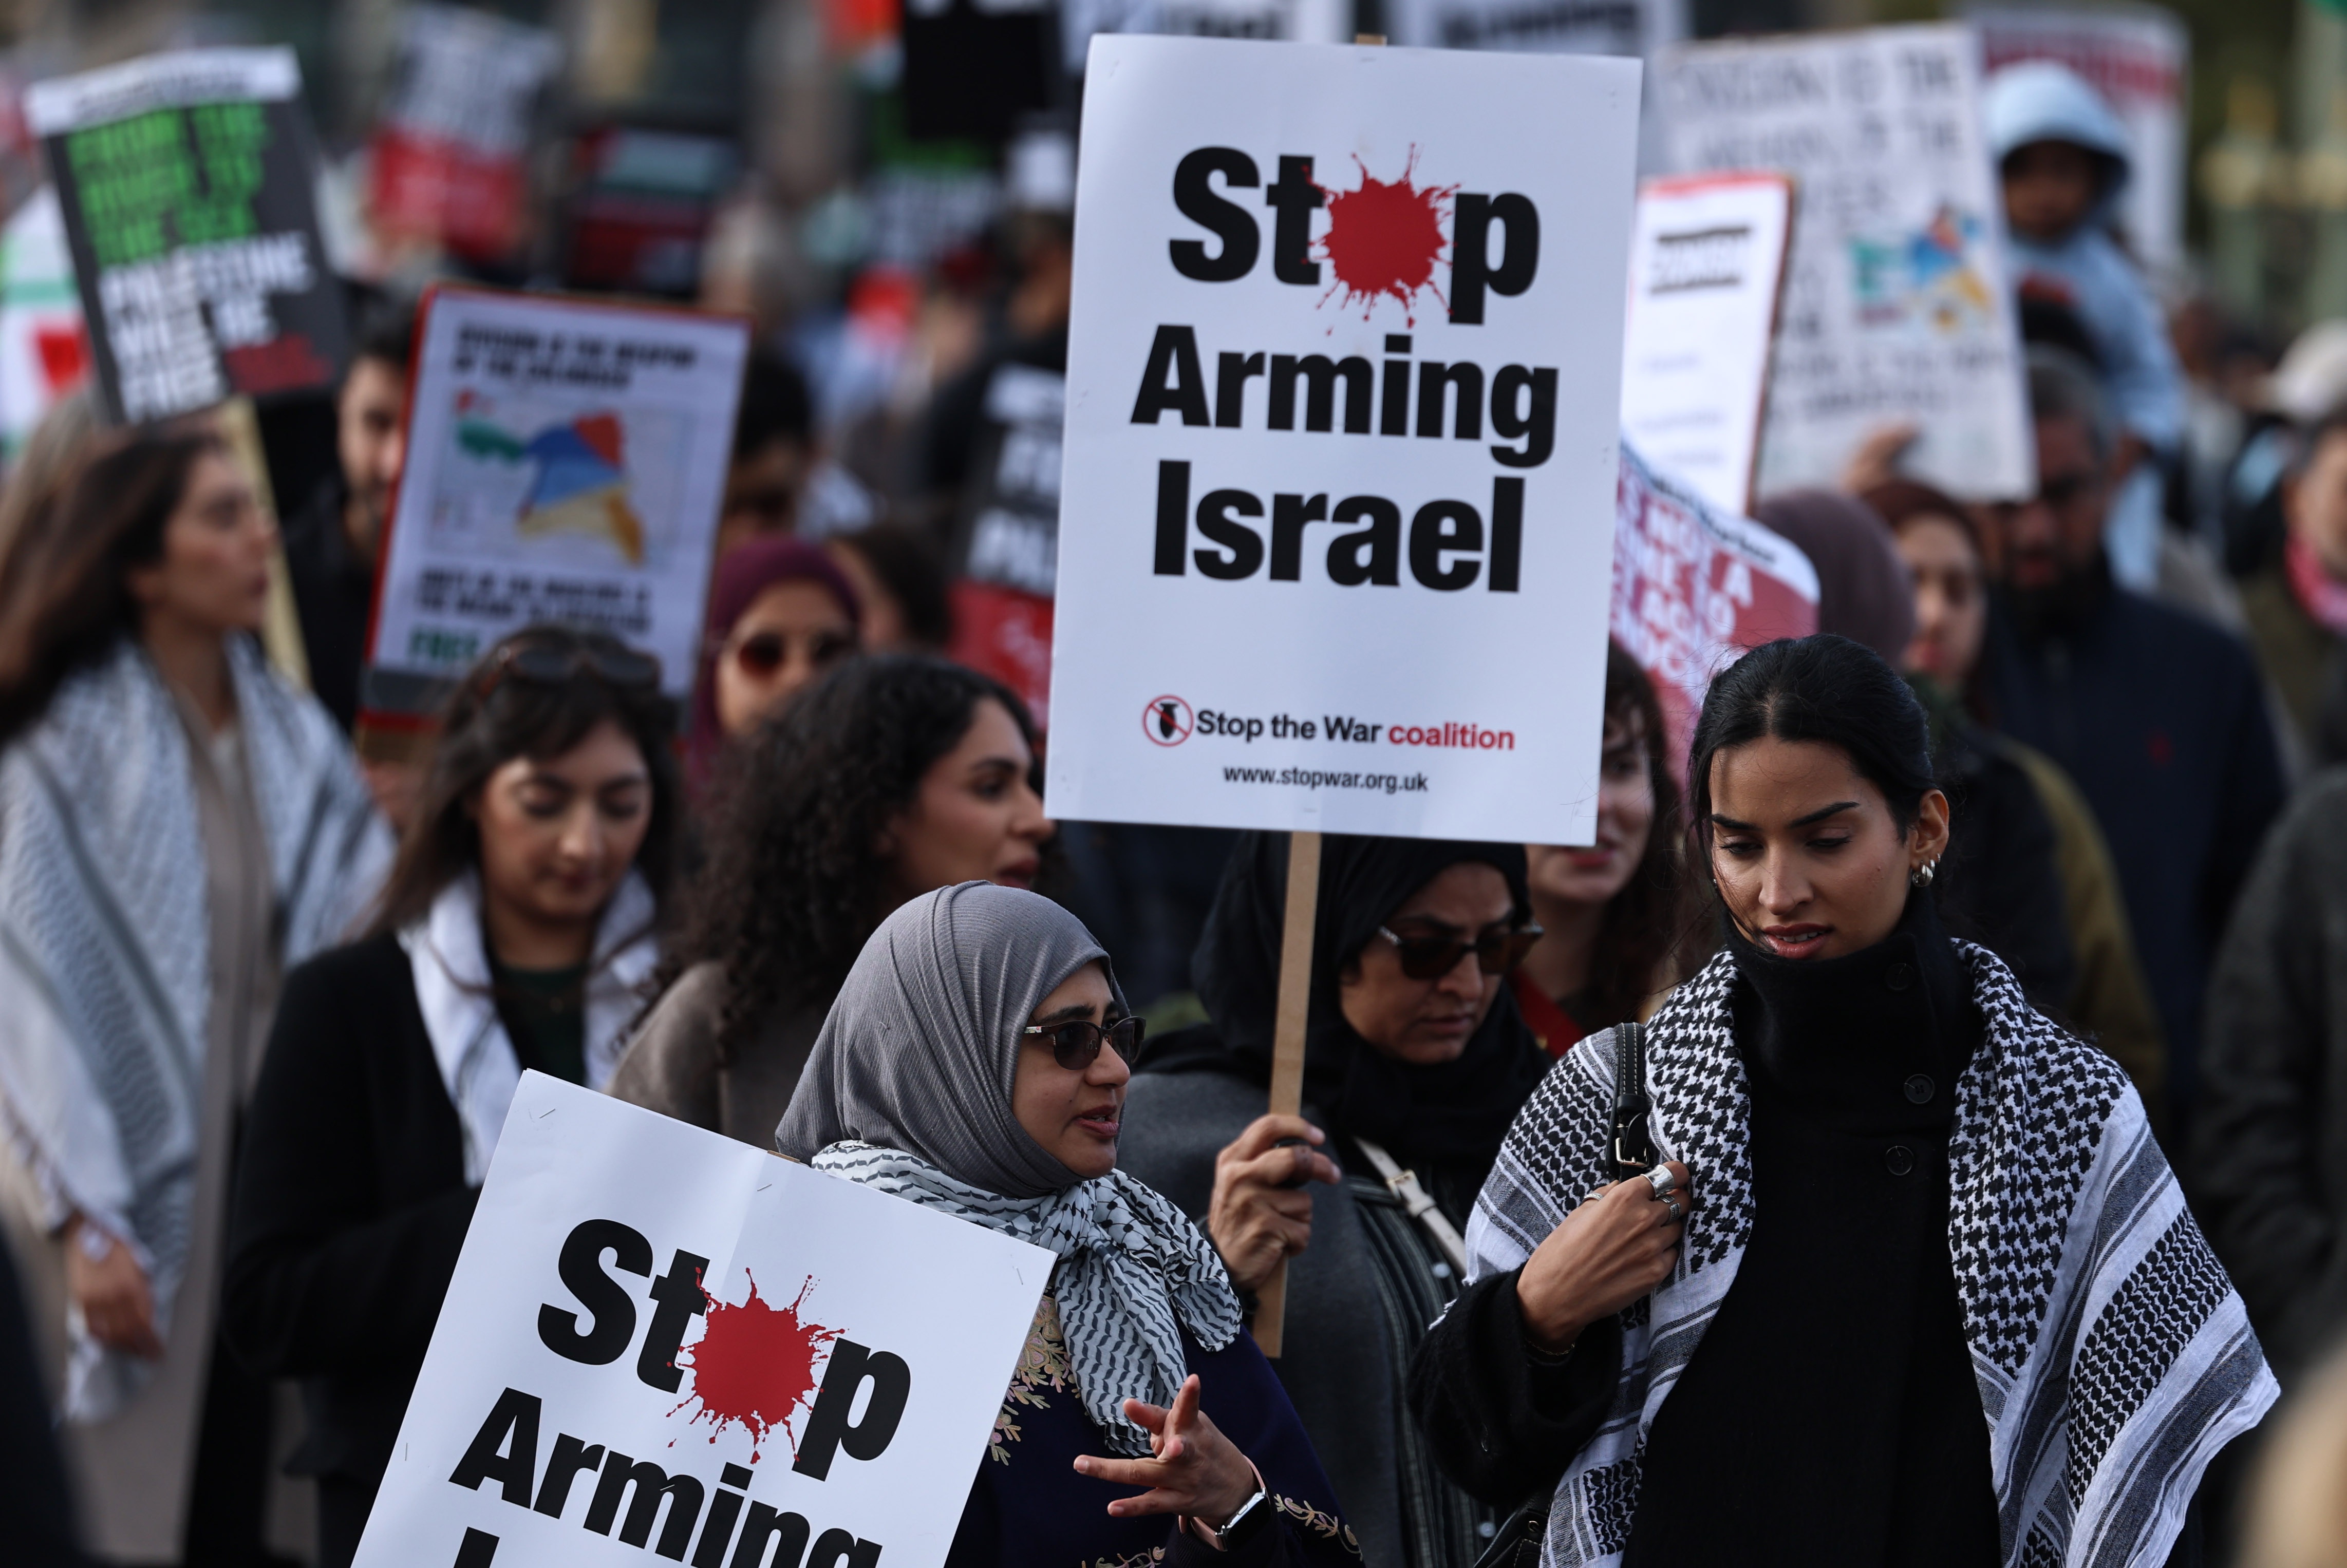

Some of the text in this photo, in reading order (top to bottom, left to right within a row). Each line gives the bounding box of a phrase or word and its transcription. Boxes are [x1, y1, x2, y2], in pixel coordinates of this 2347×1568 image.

[1130, 324, 1559, 468] Arming
[1153, 460, 1526, 593] Israel
[1196, 709, 1515, 750] Stop the War coalition
[1223, 766, 1428, 796] www.stopwar.org.uk
